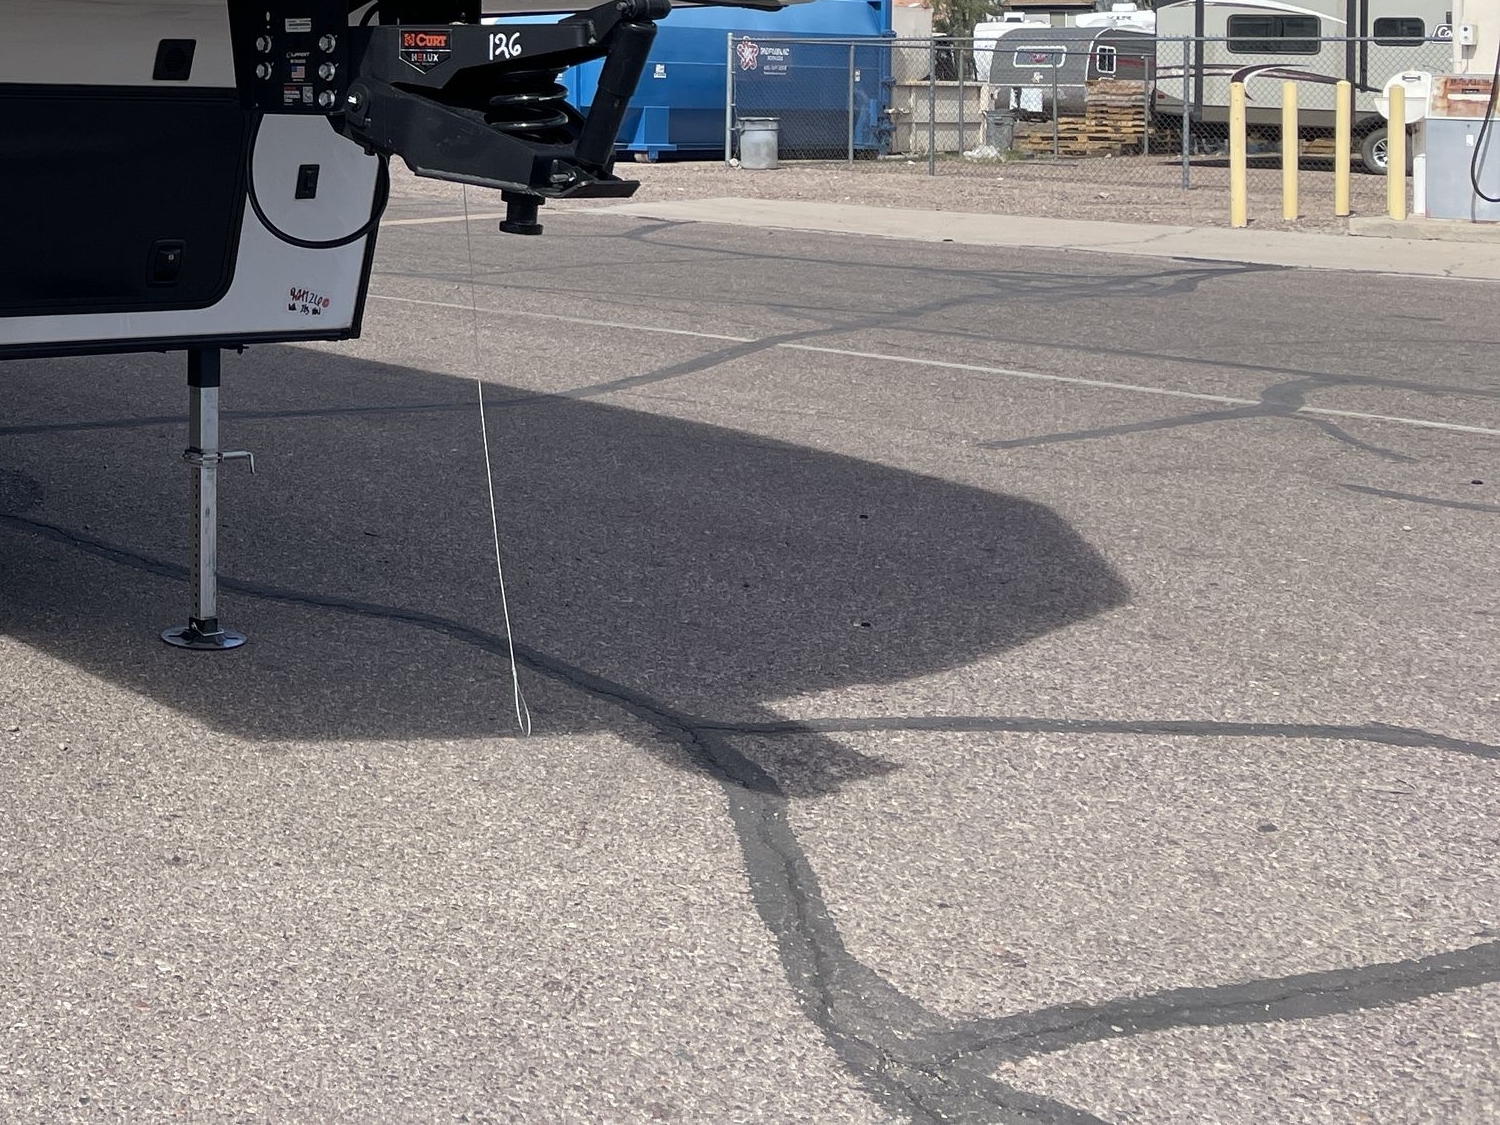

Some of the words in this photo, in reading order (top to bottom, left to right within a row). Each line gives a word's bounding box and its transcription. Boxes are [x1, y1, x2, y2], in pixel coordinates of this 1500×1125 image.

[416, 33, 447, 47] CURT
[489, 32, 522, 61] 126
[411, 53, 439, 62] HELUX
